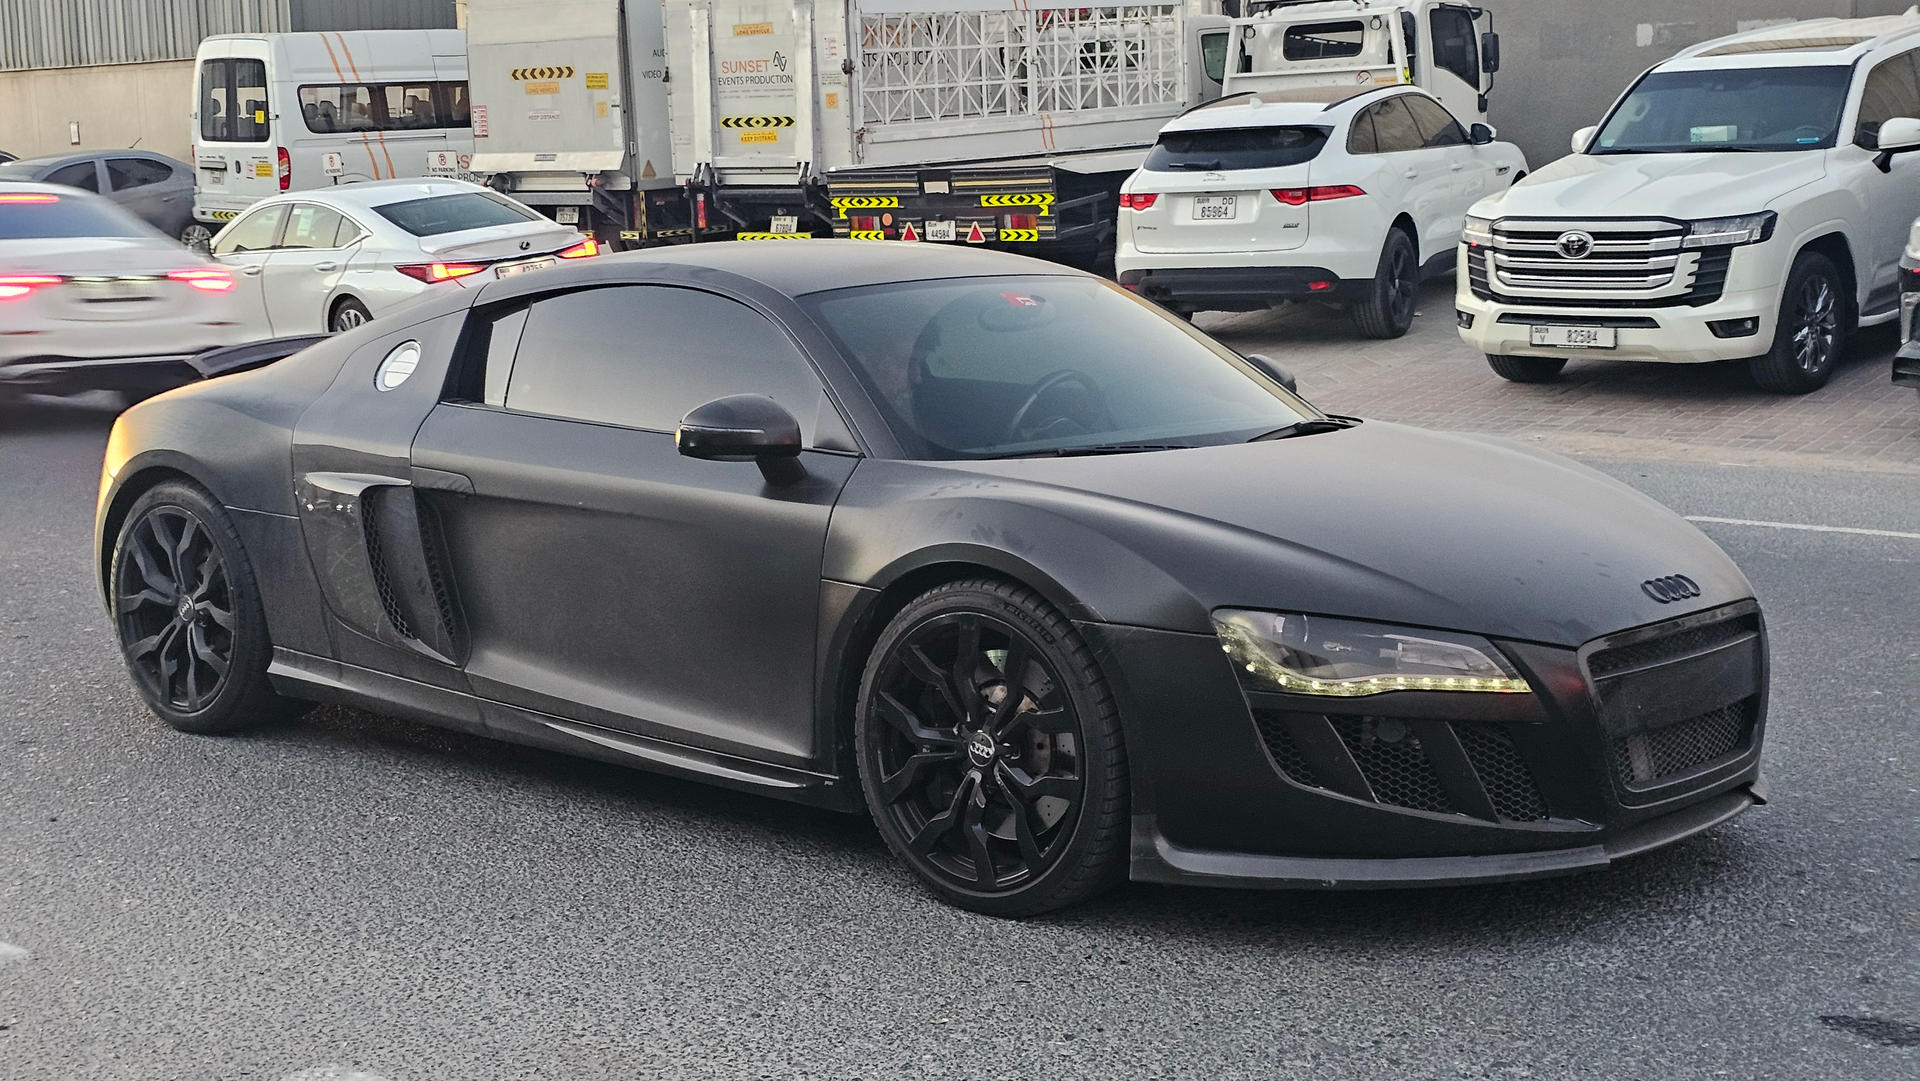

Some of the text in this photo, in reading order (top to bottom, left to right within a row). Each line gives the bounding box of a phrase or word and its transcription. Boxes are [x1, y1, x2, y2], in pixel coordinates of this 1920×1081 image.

[721, 59, 770, 74] SUNSET
[641, 69, 662, 79] VIDEO
[718, 74, 793, 86] EVENTS PRODUCTION
[1222, 197, 1234, 205] DD
